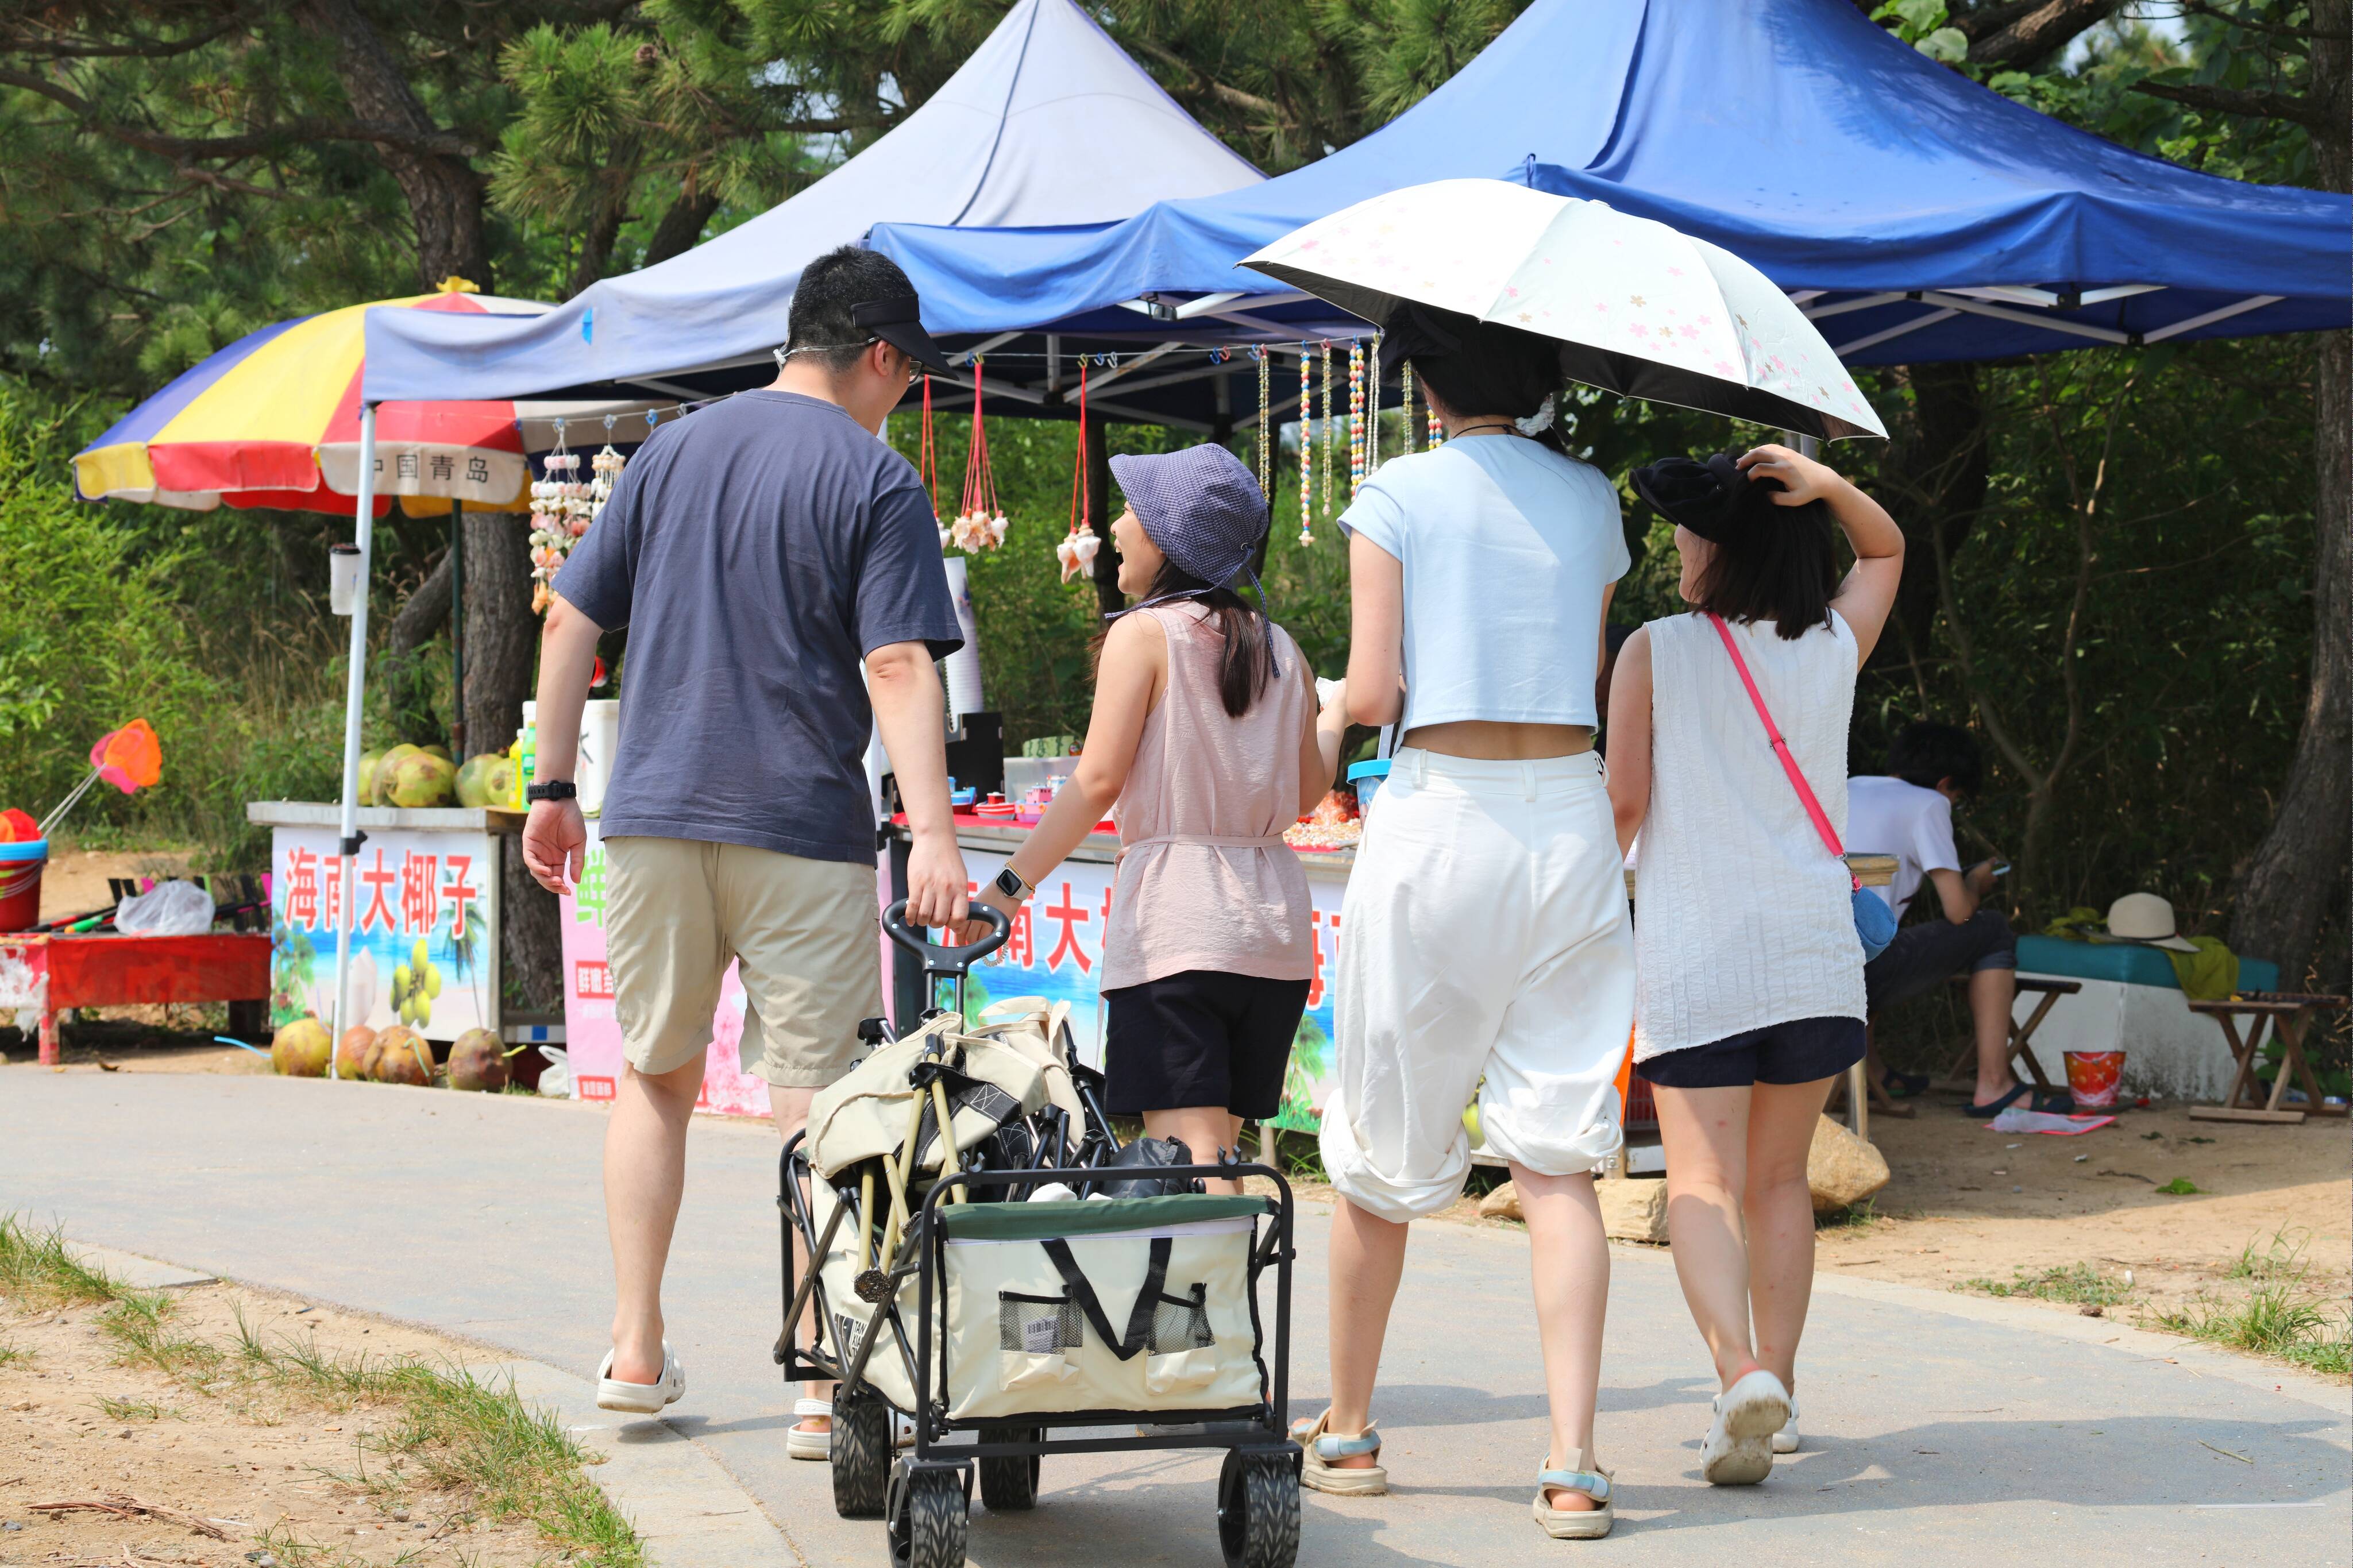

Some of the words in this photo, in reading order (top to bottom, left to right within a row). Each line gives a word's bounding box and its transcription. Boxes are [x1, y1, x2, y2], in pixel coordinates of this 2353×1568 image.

[284, 845, 476, 936] 海南大椰子
